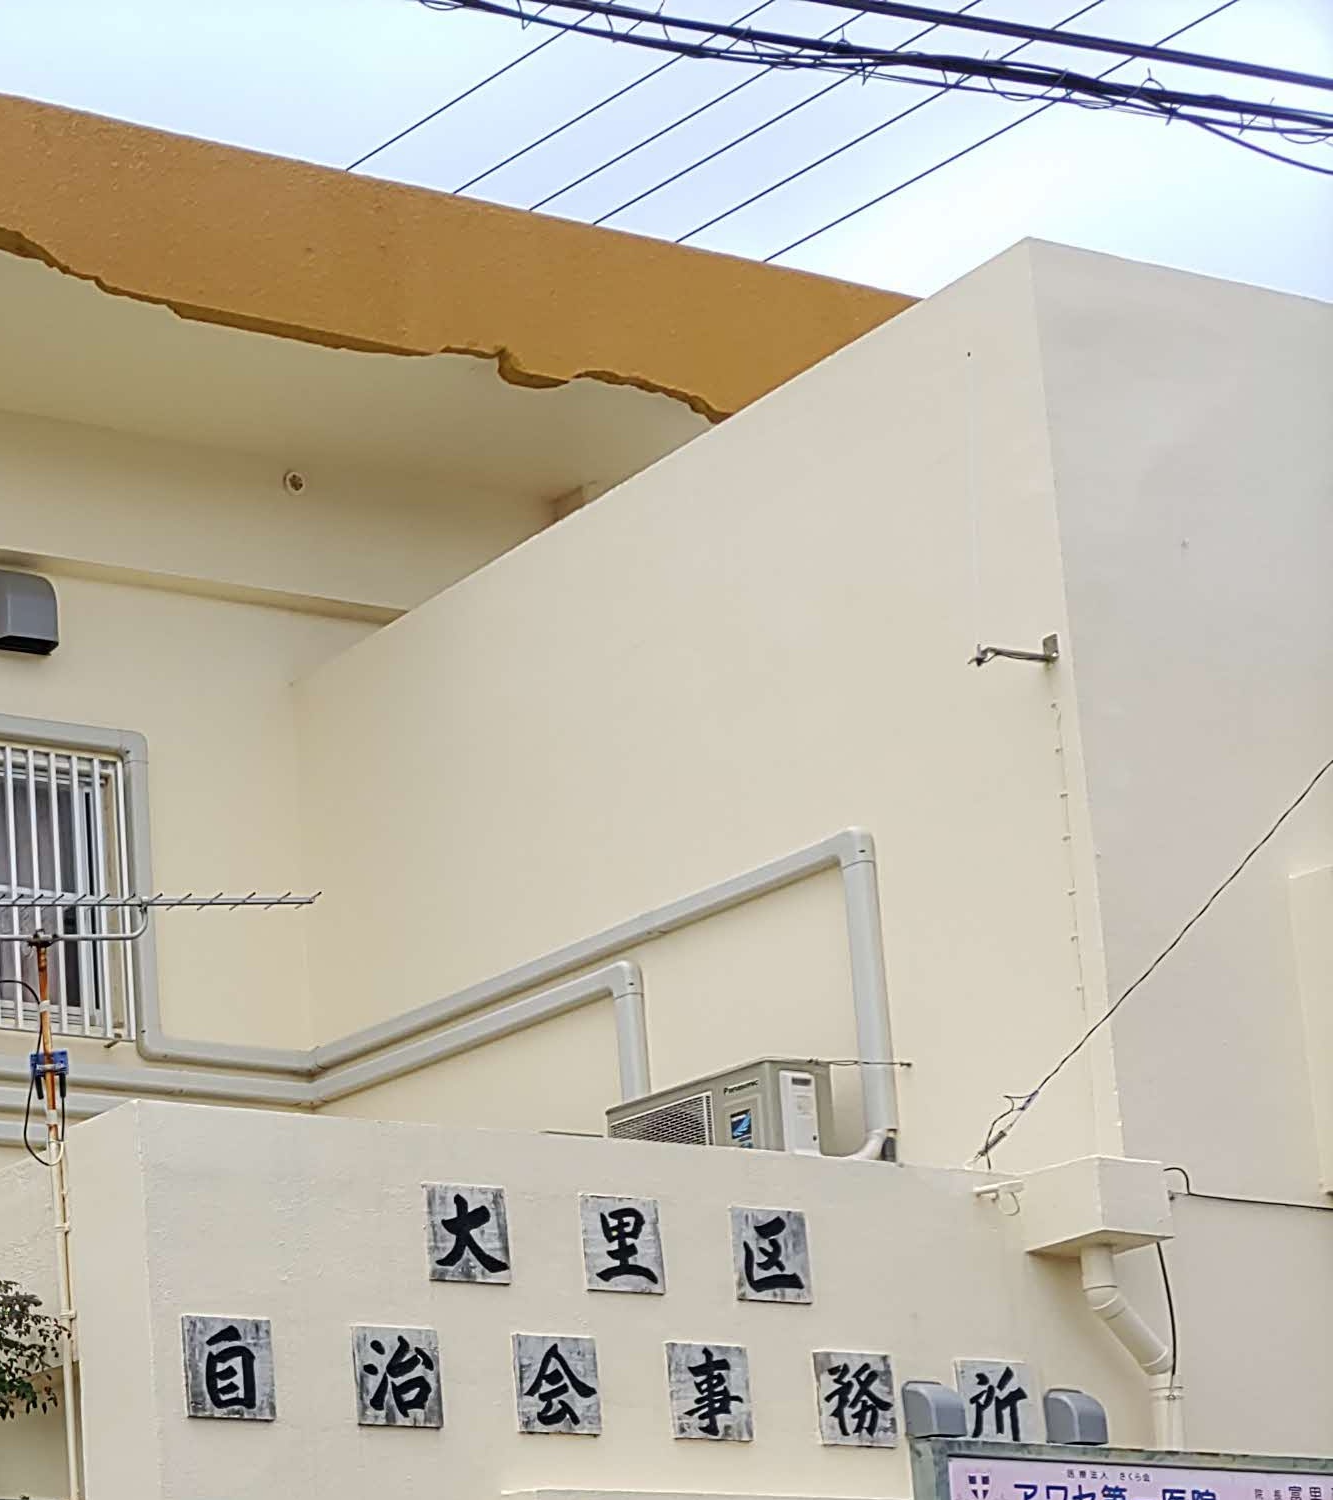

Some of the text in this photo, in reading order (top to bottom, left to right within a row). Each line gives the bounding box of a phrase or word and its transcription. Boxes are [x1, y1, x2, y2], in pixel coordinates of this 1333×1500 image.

[434, 1192, 806, 1294] 大里区
[204, 1324, 1030, 1443] 自治会事務所
